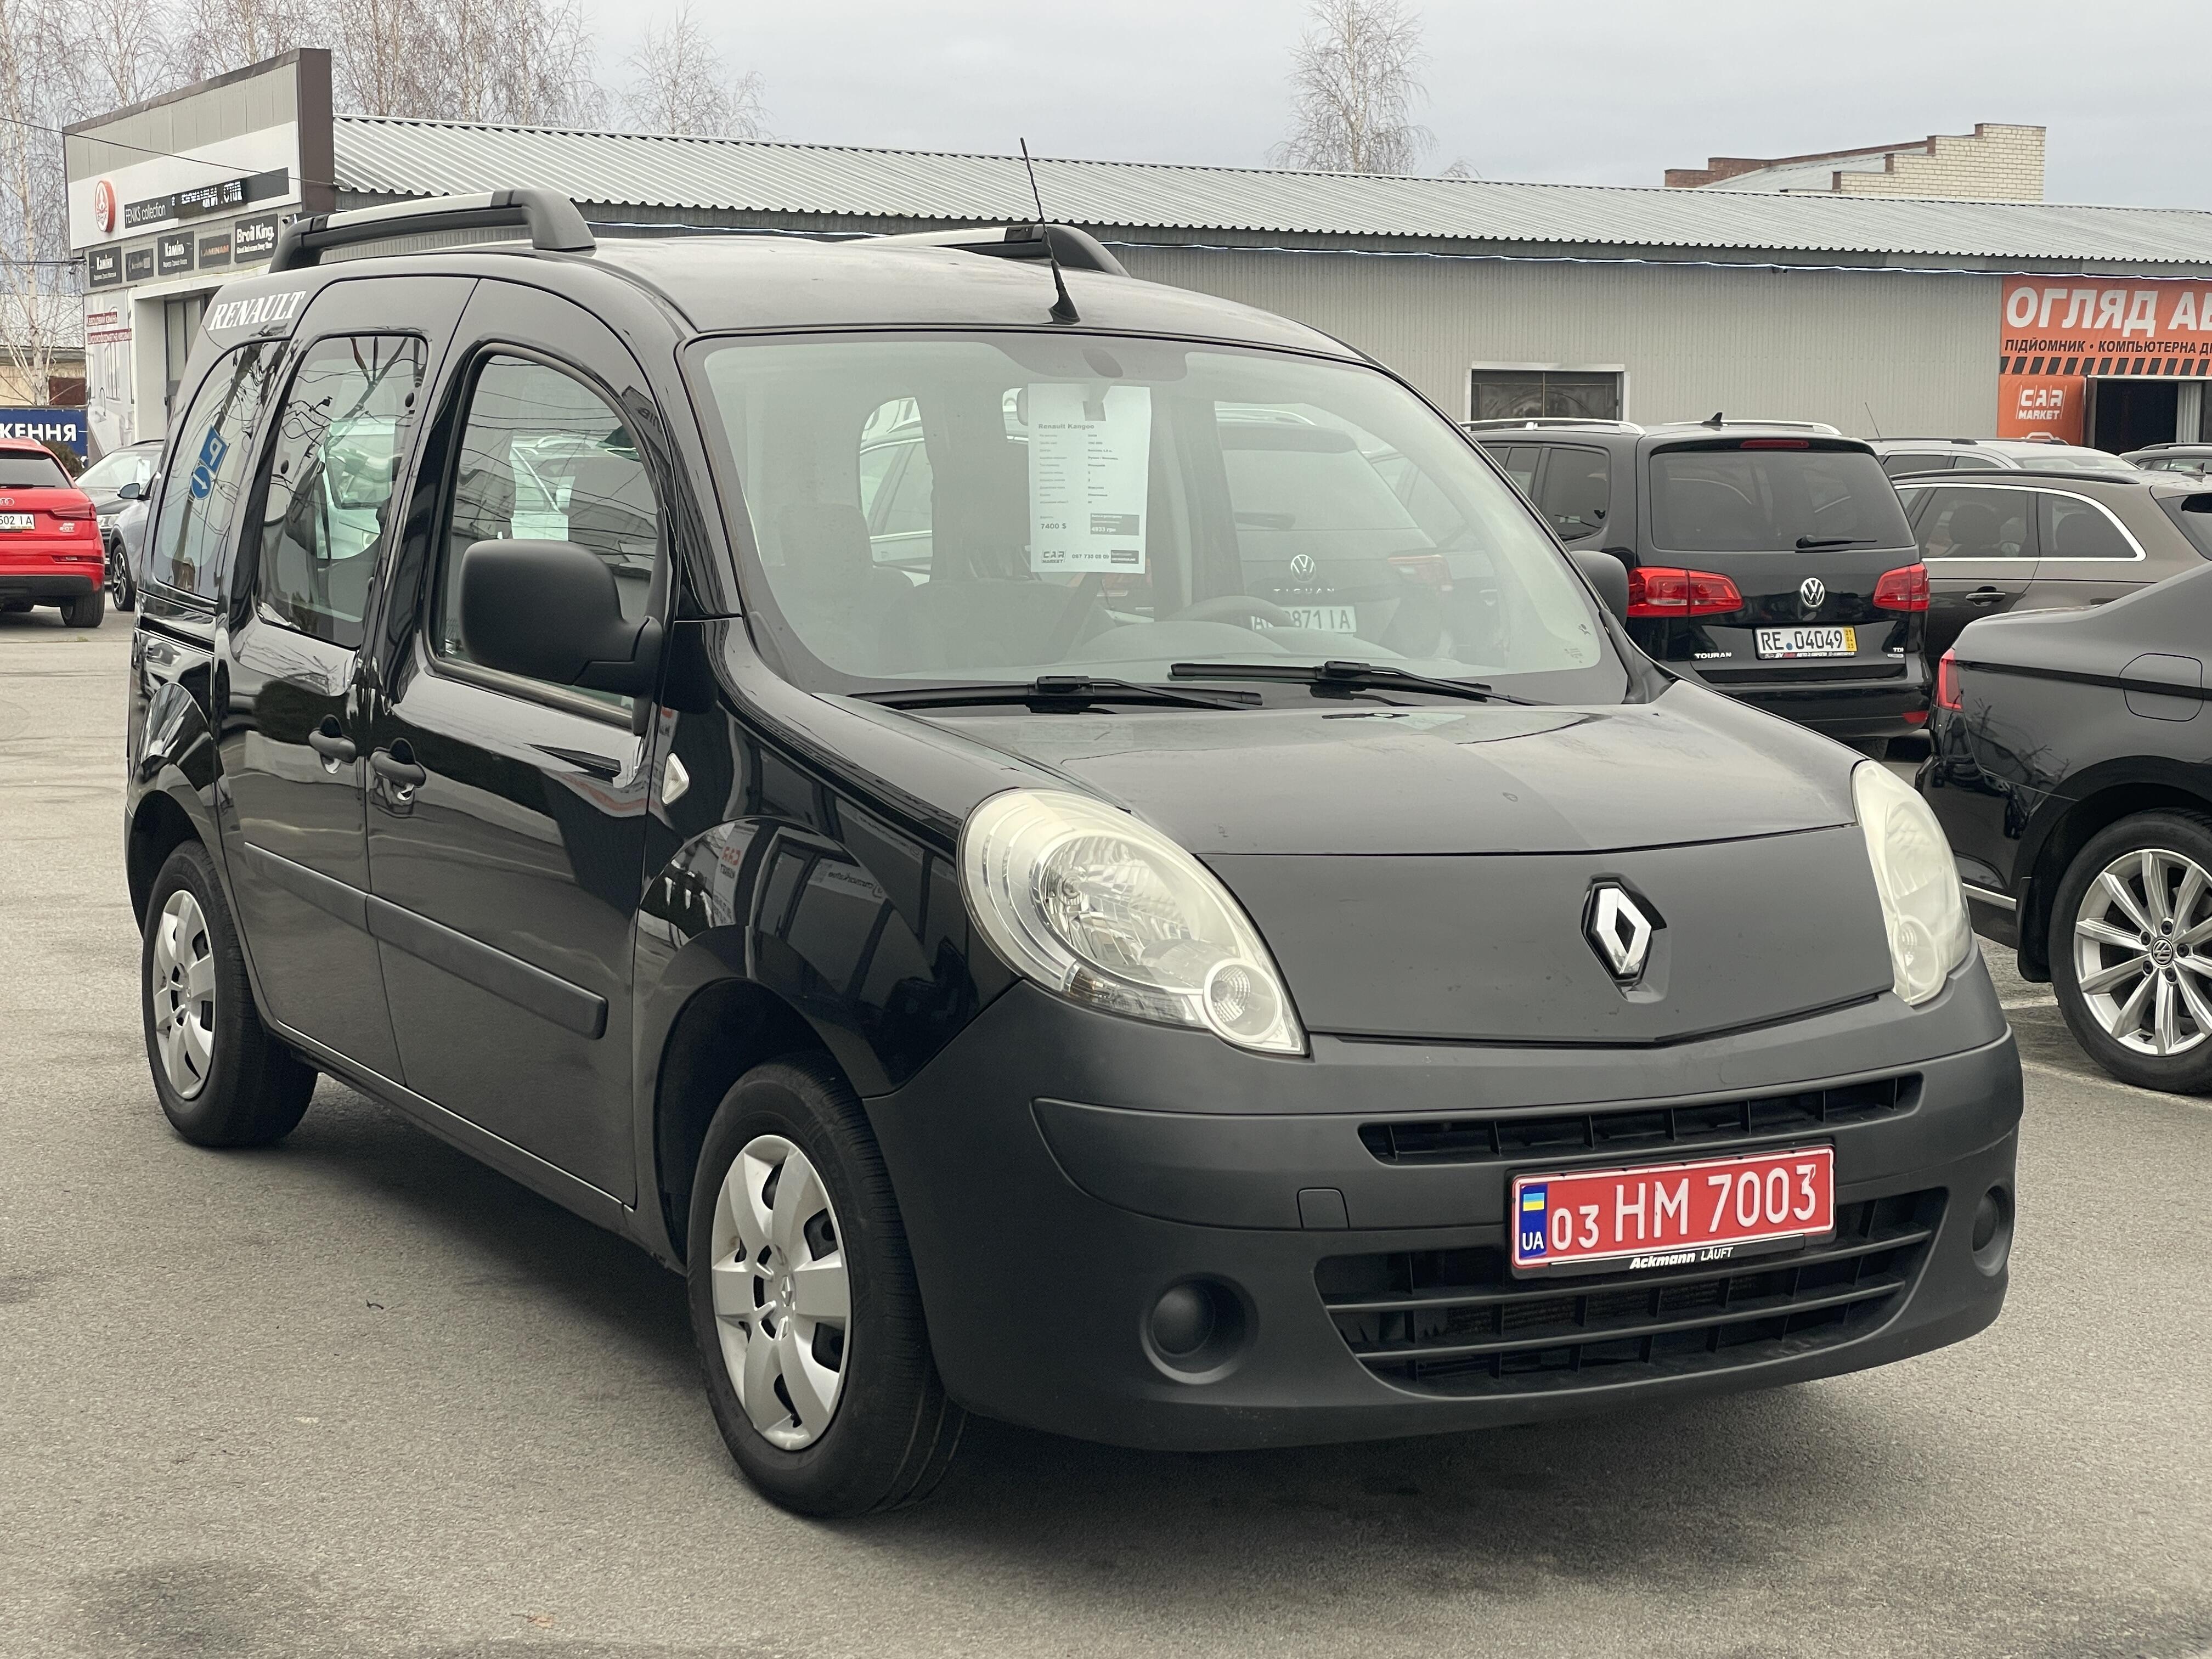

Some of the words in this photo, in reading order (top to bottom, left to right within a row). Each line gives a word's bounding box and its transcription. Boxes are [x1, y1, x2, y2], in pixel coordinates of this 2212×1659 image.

[125, 206, 140, 224] FENIKS
[142, 201, 166, 220] collection
[236, 224, 255, 244] Broil
[207, 290, 307, 331] RENAULT
[2006, 287, 2158, 337] ОГЛЯД
[2005, 337, 2085, 353] ПІДЙОМНИК
[2098, 341, 2196, 353] КОМПЬЮТЕРНА
[2020, 389, 2063, 407] CAR
[2018, 410, 2061, 420] MARKET
[1760, 631, 1784, 651] RE
[1793, 630, 1843, 650] 04049
[1551, 1204, 1599, 1251] 03
[1615, 1178, 1689, 1242] HM
[1707, 1164, 1816, 1233] 7003
[1522, 1231, 1544, 1251] UA
[1629, 1252, 1696, 1269] Ackmann
[1701, 1246, 1734, 1261] LÄUFT
